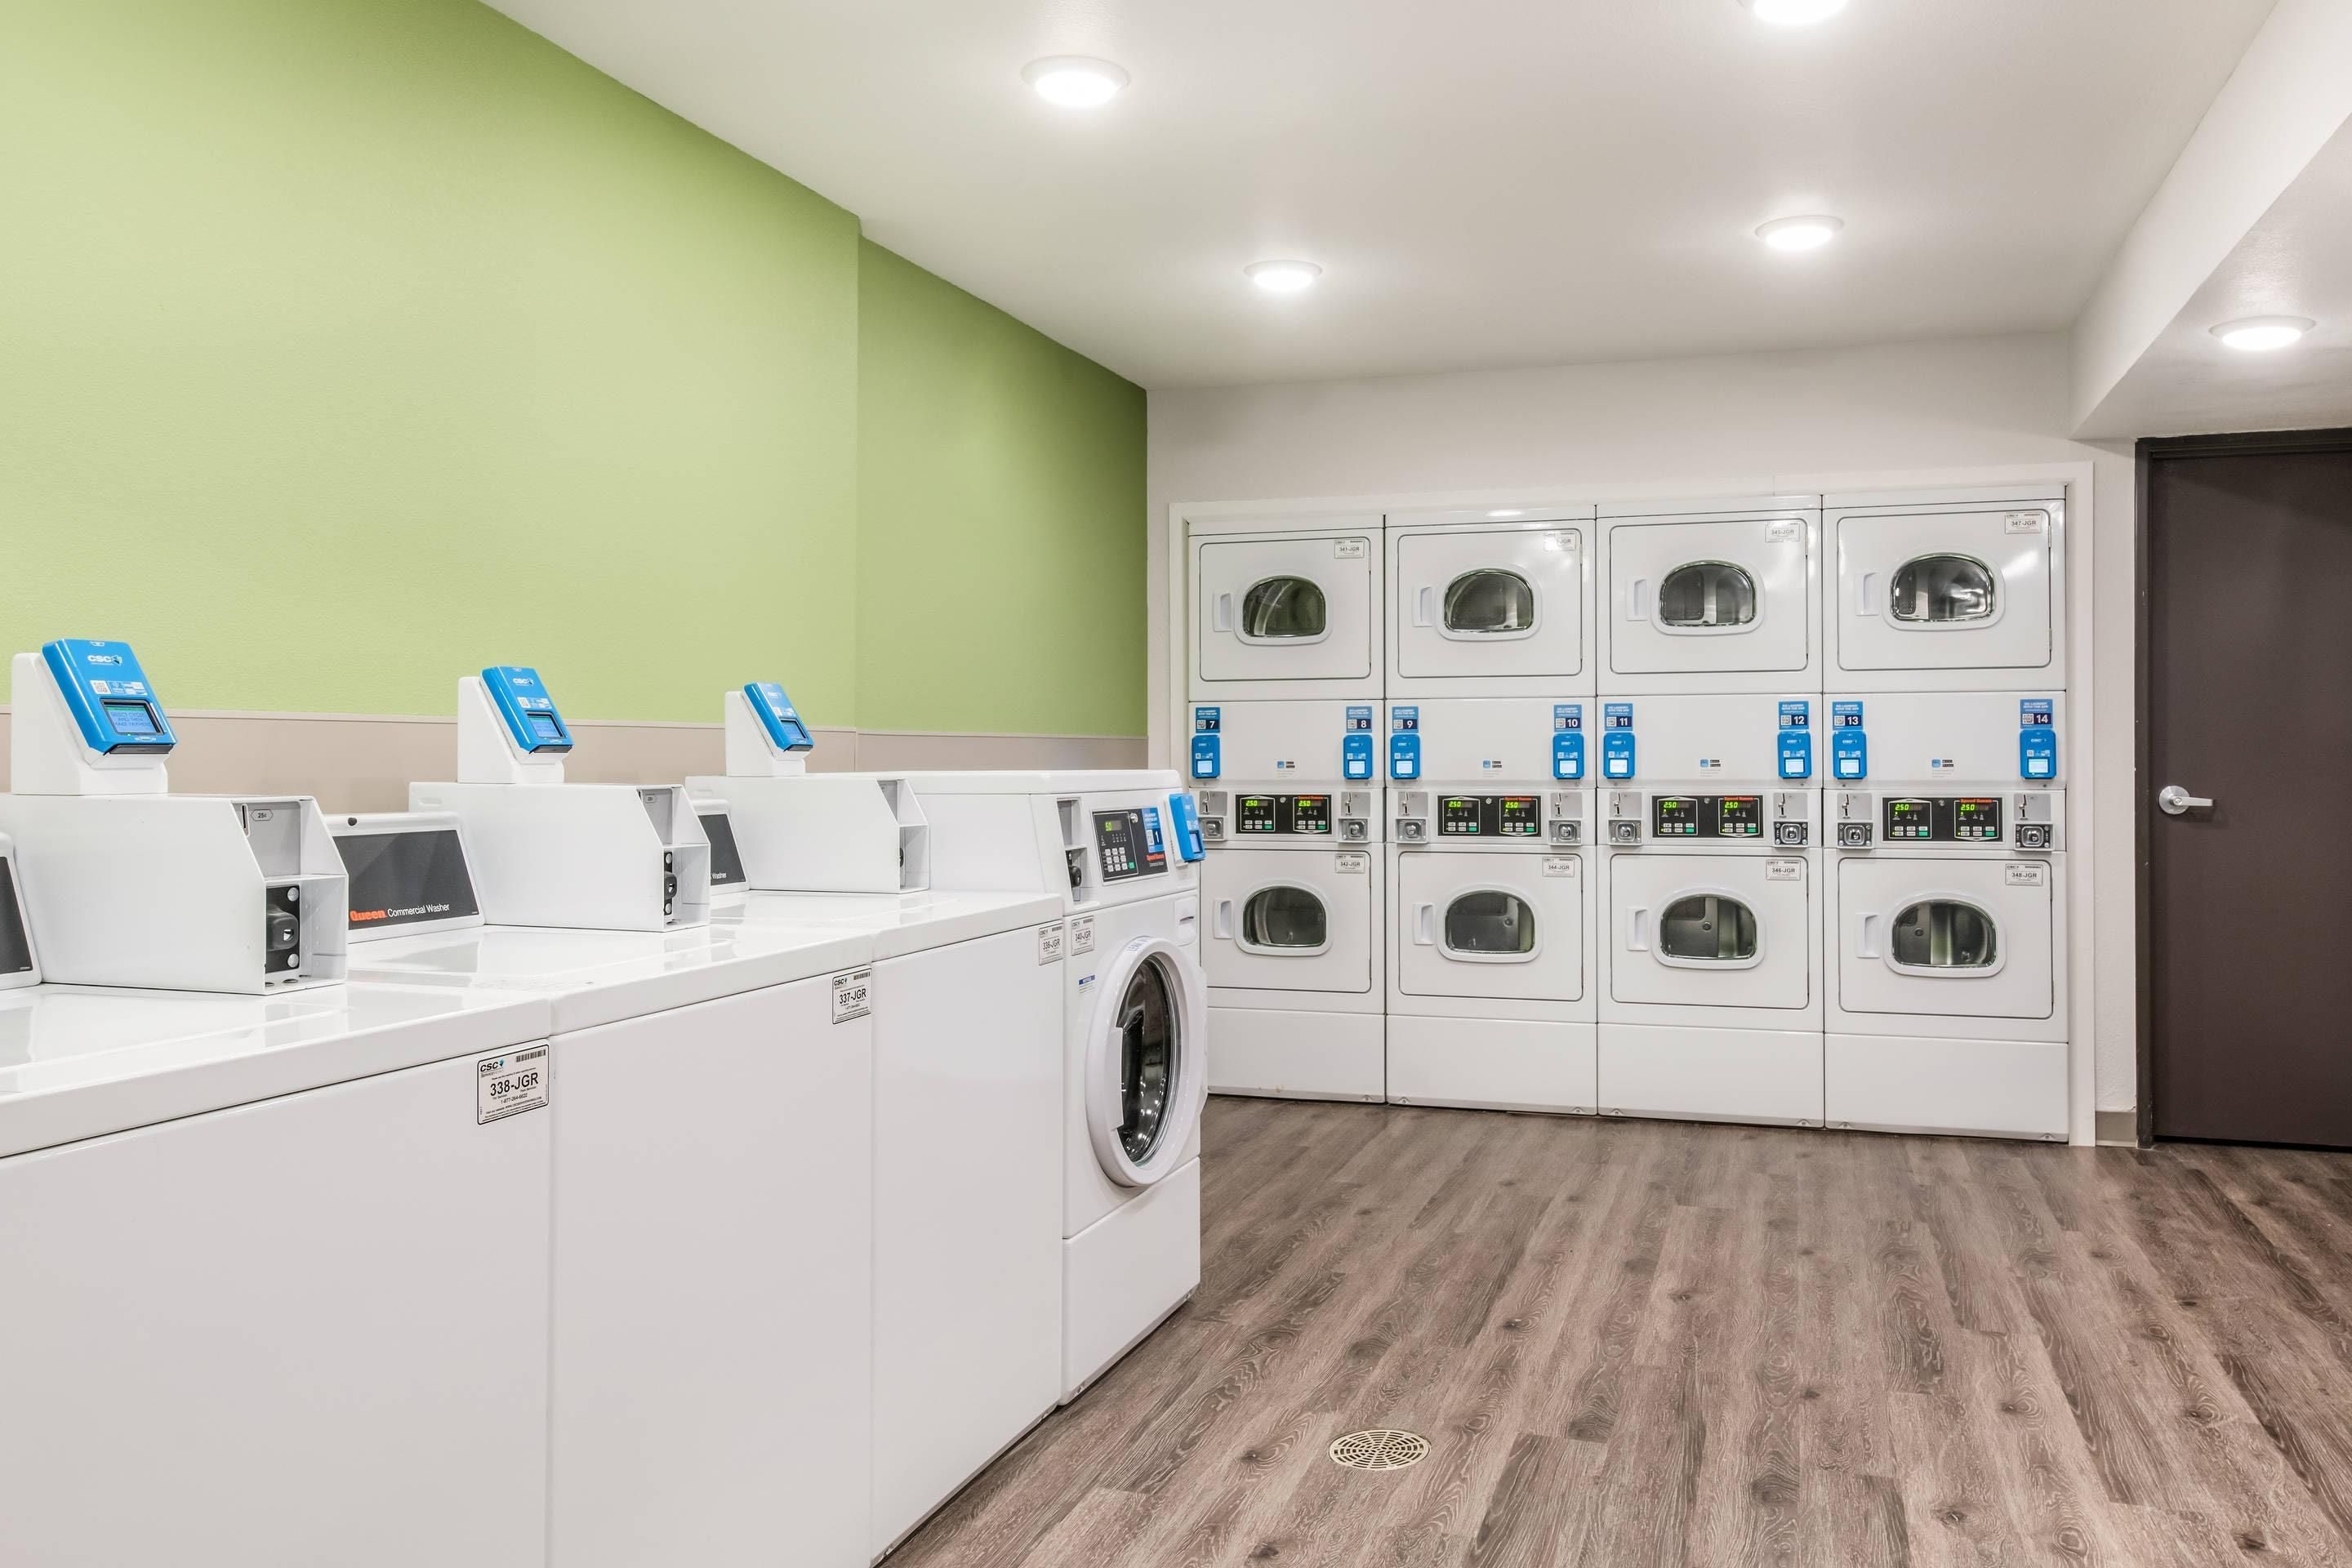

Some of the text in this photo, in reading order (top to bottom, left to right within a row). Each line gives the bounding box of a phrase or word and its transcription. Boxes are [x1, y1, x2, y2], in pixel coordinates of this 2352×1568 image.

[87, 655, 112, 663] CSC
[1361, 719, 1367, 728] 8
[1567, 719, 1578, 728] 10
[1619, 717, 1628, 726] 11
[1793, 715, 1805, 724] 12
[1847, 716, 1859, 725] 13
[2036, 714, 2049, 724] 14
[1209, 720, 1215, 728] 7
[1406, 720, 1413, 728] 9
[1155, 831, 1160, 844] 1
[350, 903, 449, 922] Queen Commercial Washer
[834, 978, 844, 987] CSC
[840, 988, 866, 1004] 337-JGR
[480, 1062, 499, 1072] CSC
[490, 1072, 539, 1096] 338-JGR
